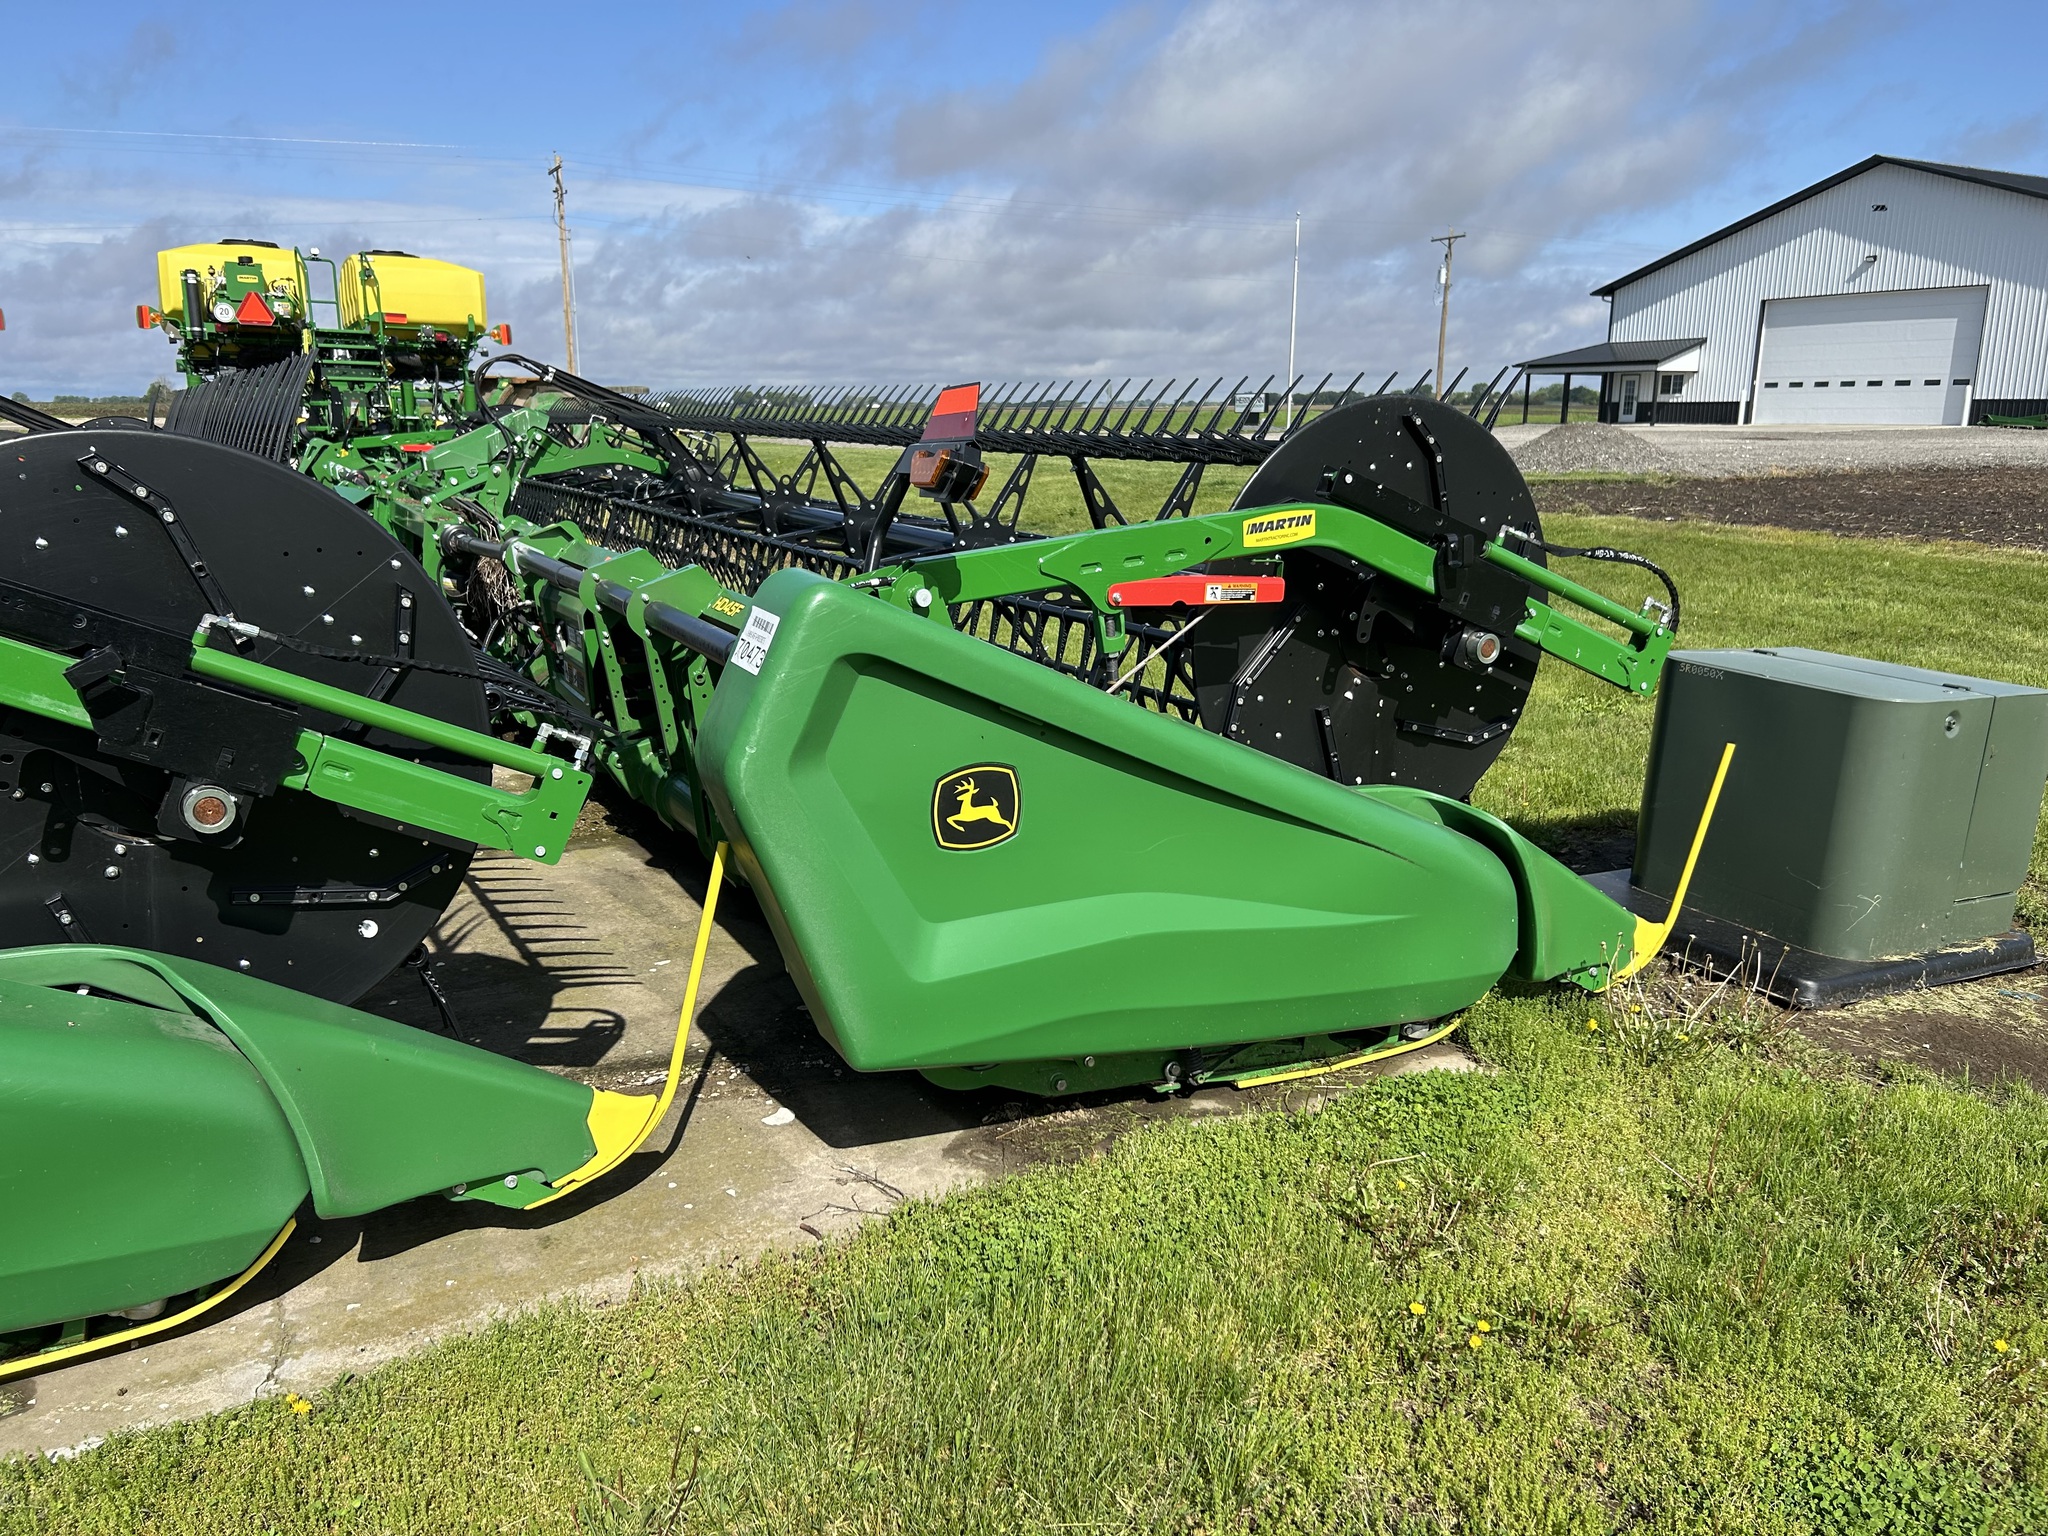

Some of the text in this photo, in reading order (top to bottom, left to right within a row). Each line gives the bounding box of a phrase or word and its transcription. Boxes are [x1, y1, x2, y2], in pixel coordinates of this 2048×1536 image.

[219, 307, 230, 316] 20
[1247, 514, 1313, 535] MARTIN
[712, 596, 746, 617] HD45F
[738, 638, 767, 669] 70473
[1679, 662, 1725, 681] SR0050X
